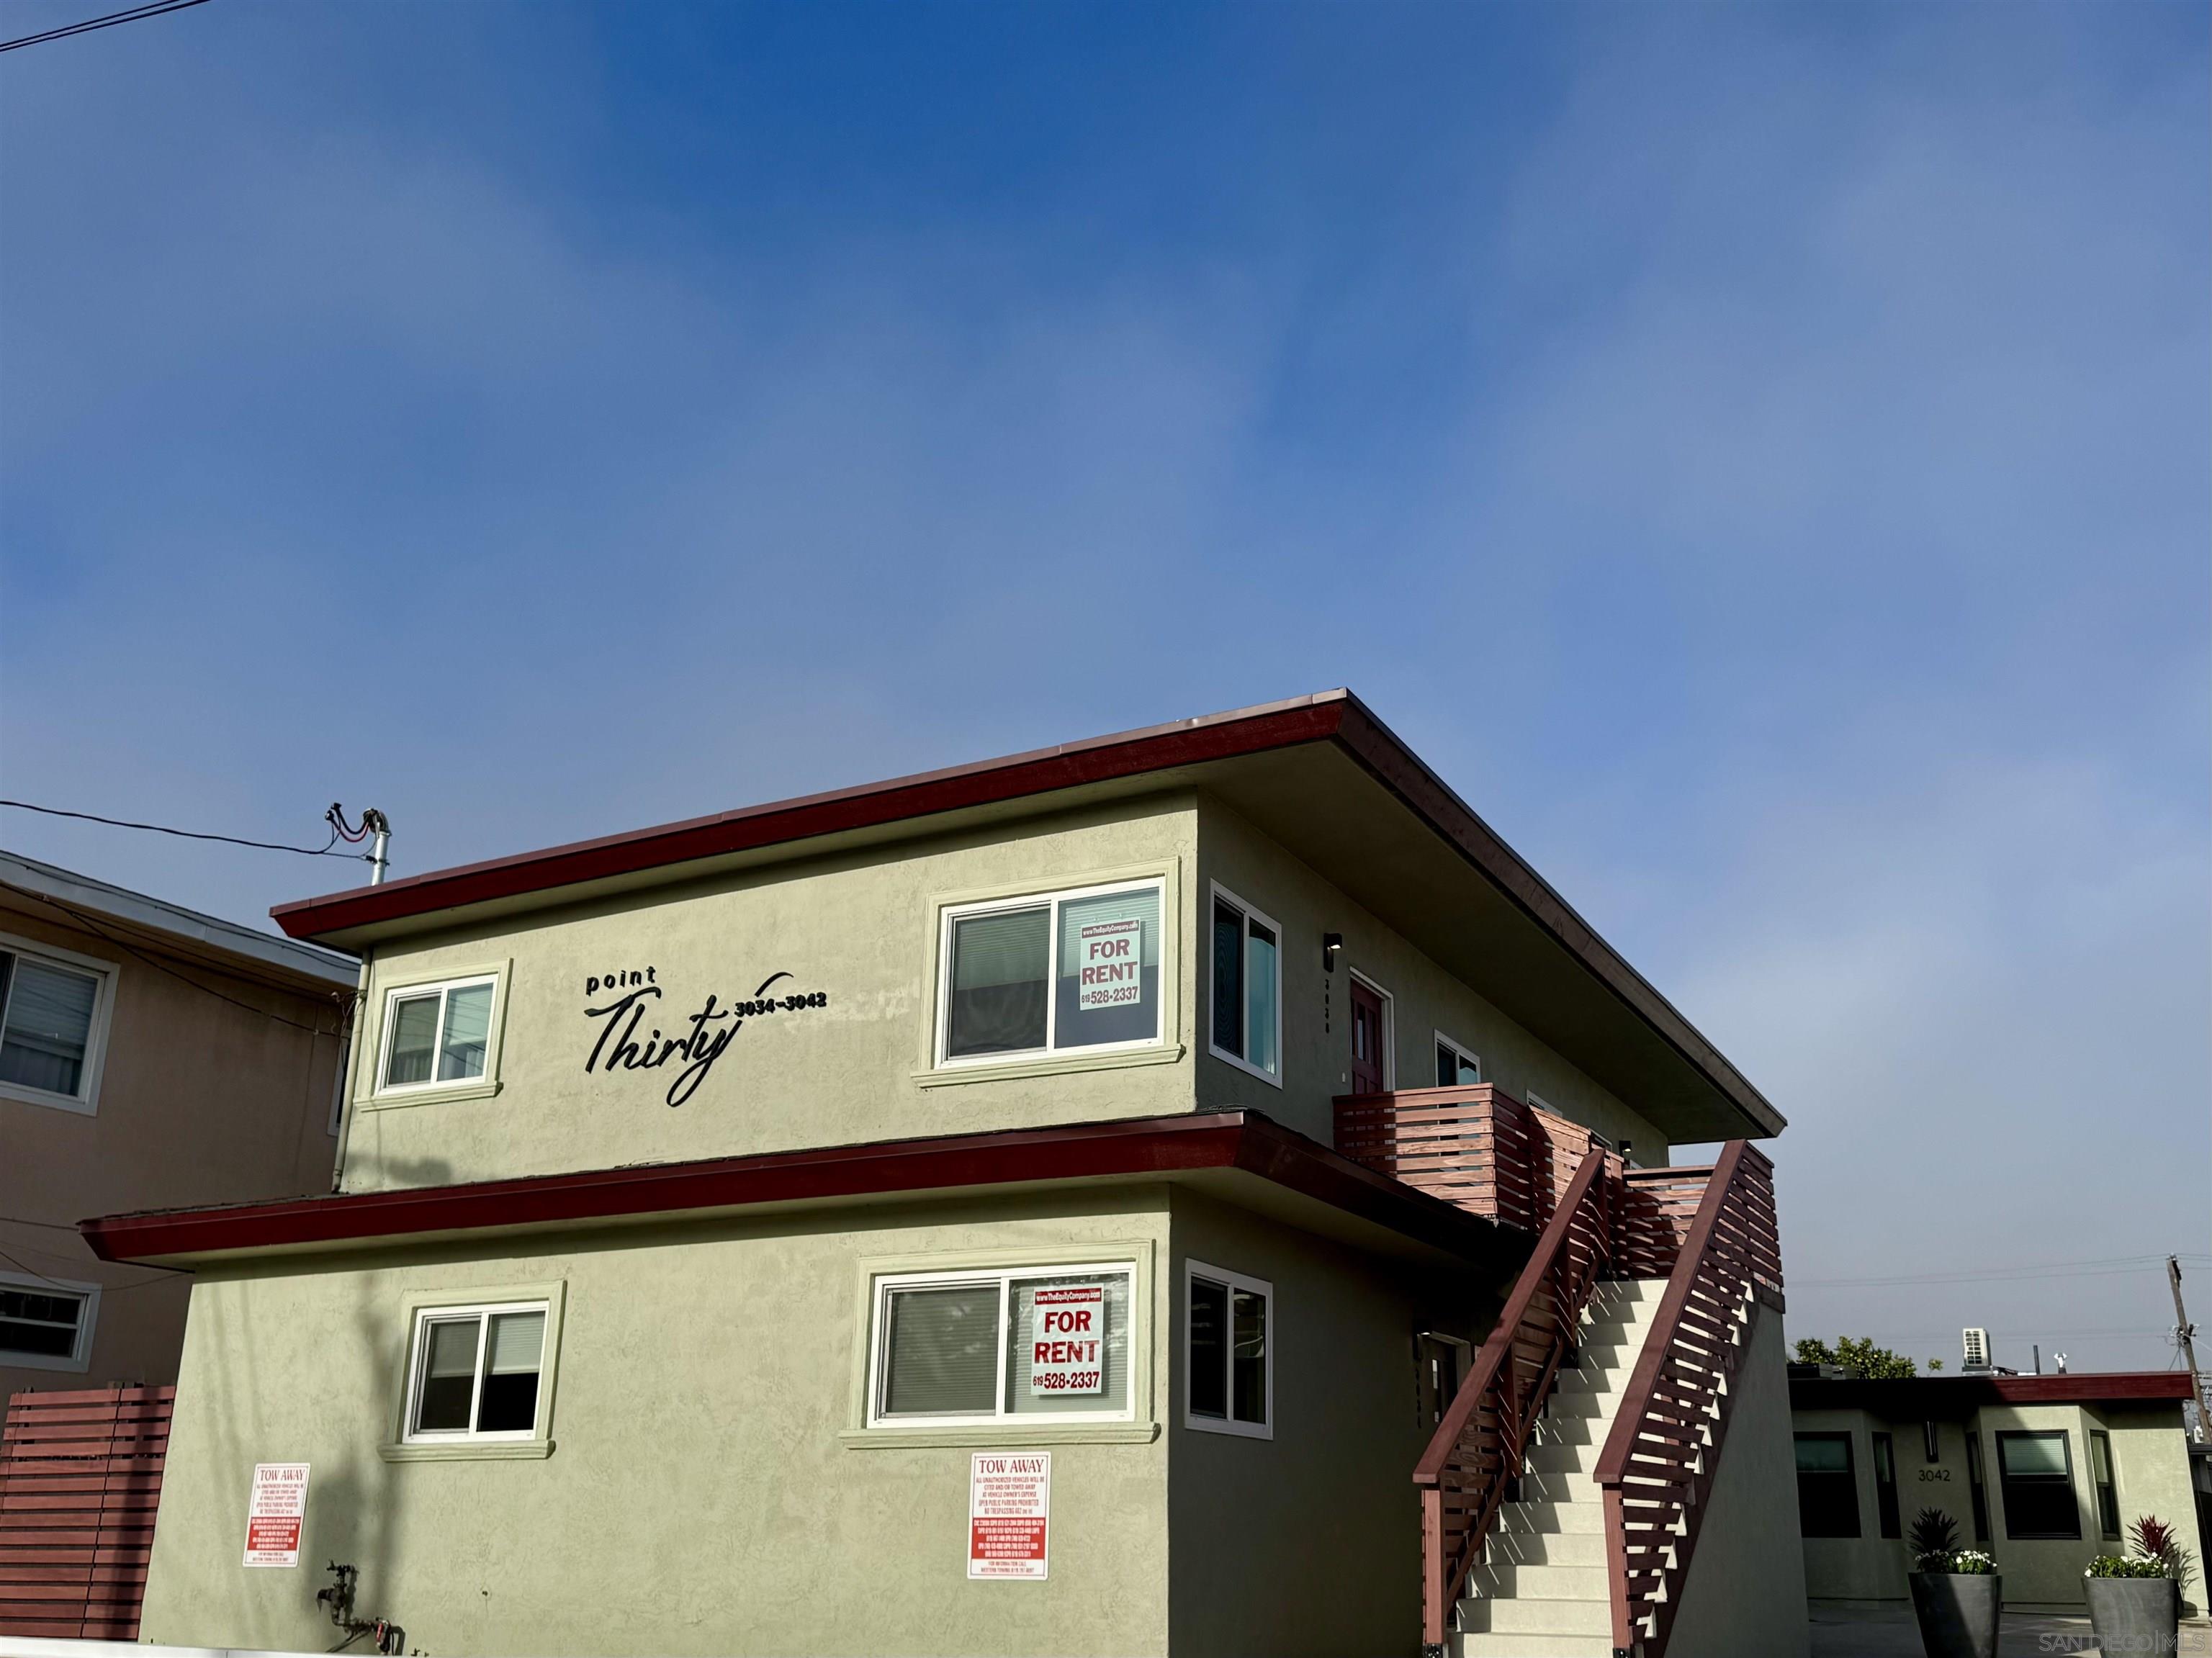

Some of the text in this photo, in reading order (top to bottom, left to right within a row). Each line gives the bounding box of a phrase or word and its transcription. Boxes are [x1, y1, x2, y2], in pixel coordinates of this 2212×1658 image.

[1089, 939, 1130, 960] FOR
[585, 966, 656, 996] point
[1082, 961, 1138, 986] RENT
[734, 992, 827, 1018] 3034-3042
[1091, 986, 1138, 1004] 528-2337
[584, 983, 745, 1107] Thirty
[1044, 1310, 1092, 1333] FOR
[1034, 1340, 1100, 1364] RENT
[1044, 1371, 1100, 1389] 528-2337
[260, 1469, 305, 1481] TOW AWAY
[979, 1459, 1044, 1474] TOW AWAY
[1918, 1469, 1951, 1482] 3042
